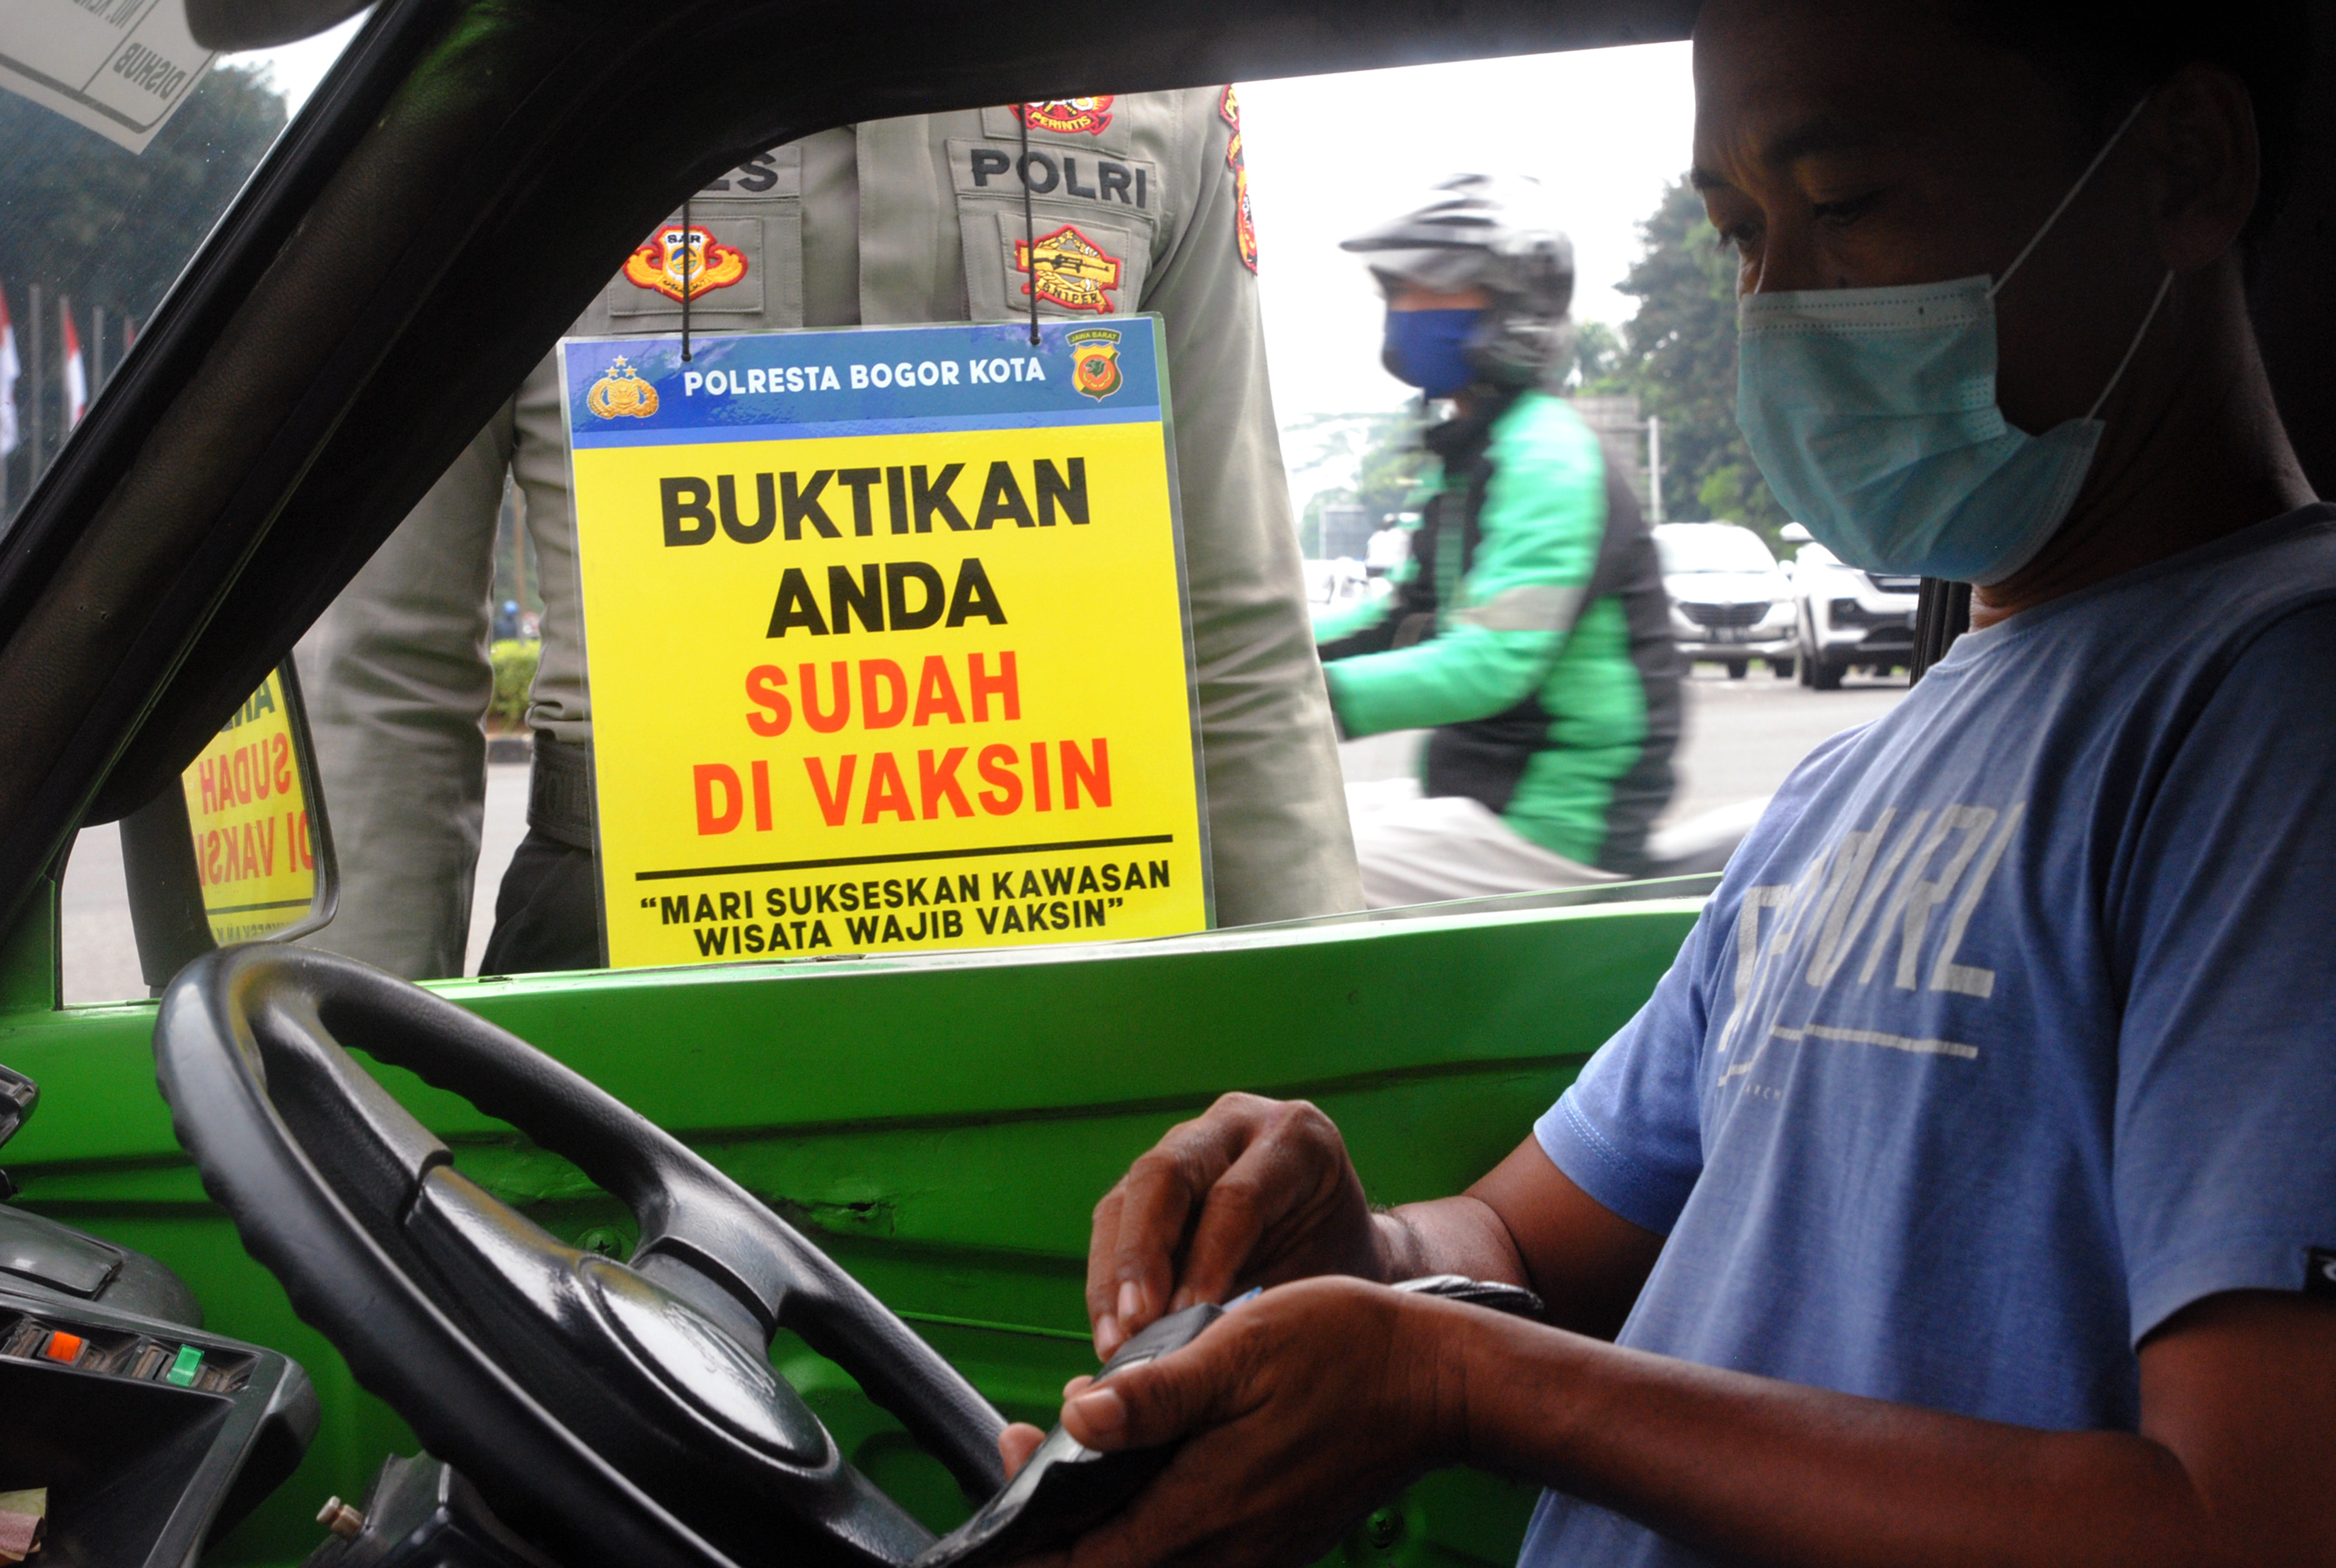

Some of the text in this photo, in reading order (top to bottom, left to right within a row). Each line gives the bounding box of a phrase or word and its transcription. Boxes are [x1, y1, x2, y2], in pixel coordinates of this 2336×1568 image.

[1031, 111, 1091, 130] PERINTIS
[970, 148, 1146, 209] POLRI
[1042, 281, 1098, 305] SNIPER
[1071, 331, 1117, 342] JAWA BARAT
[684, 357, 1046, 397] POLRESTA BOGOR KOTA
[659, 457, 1091, 547] BUKTIKAN
[766, 558, 1008, 639] ANDA
[745, 651, 1021, 738] SUDAH
[693, 738, 1113, 836] DI VAKSIN
[766, 874, 980, 917] SUKSESKAN
[993, 860, 1170, 901] KAWASAN
[694, 920, 832, 957] WISATA
[846, 908, 964, 946] WAJIB
